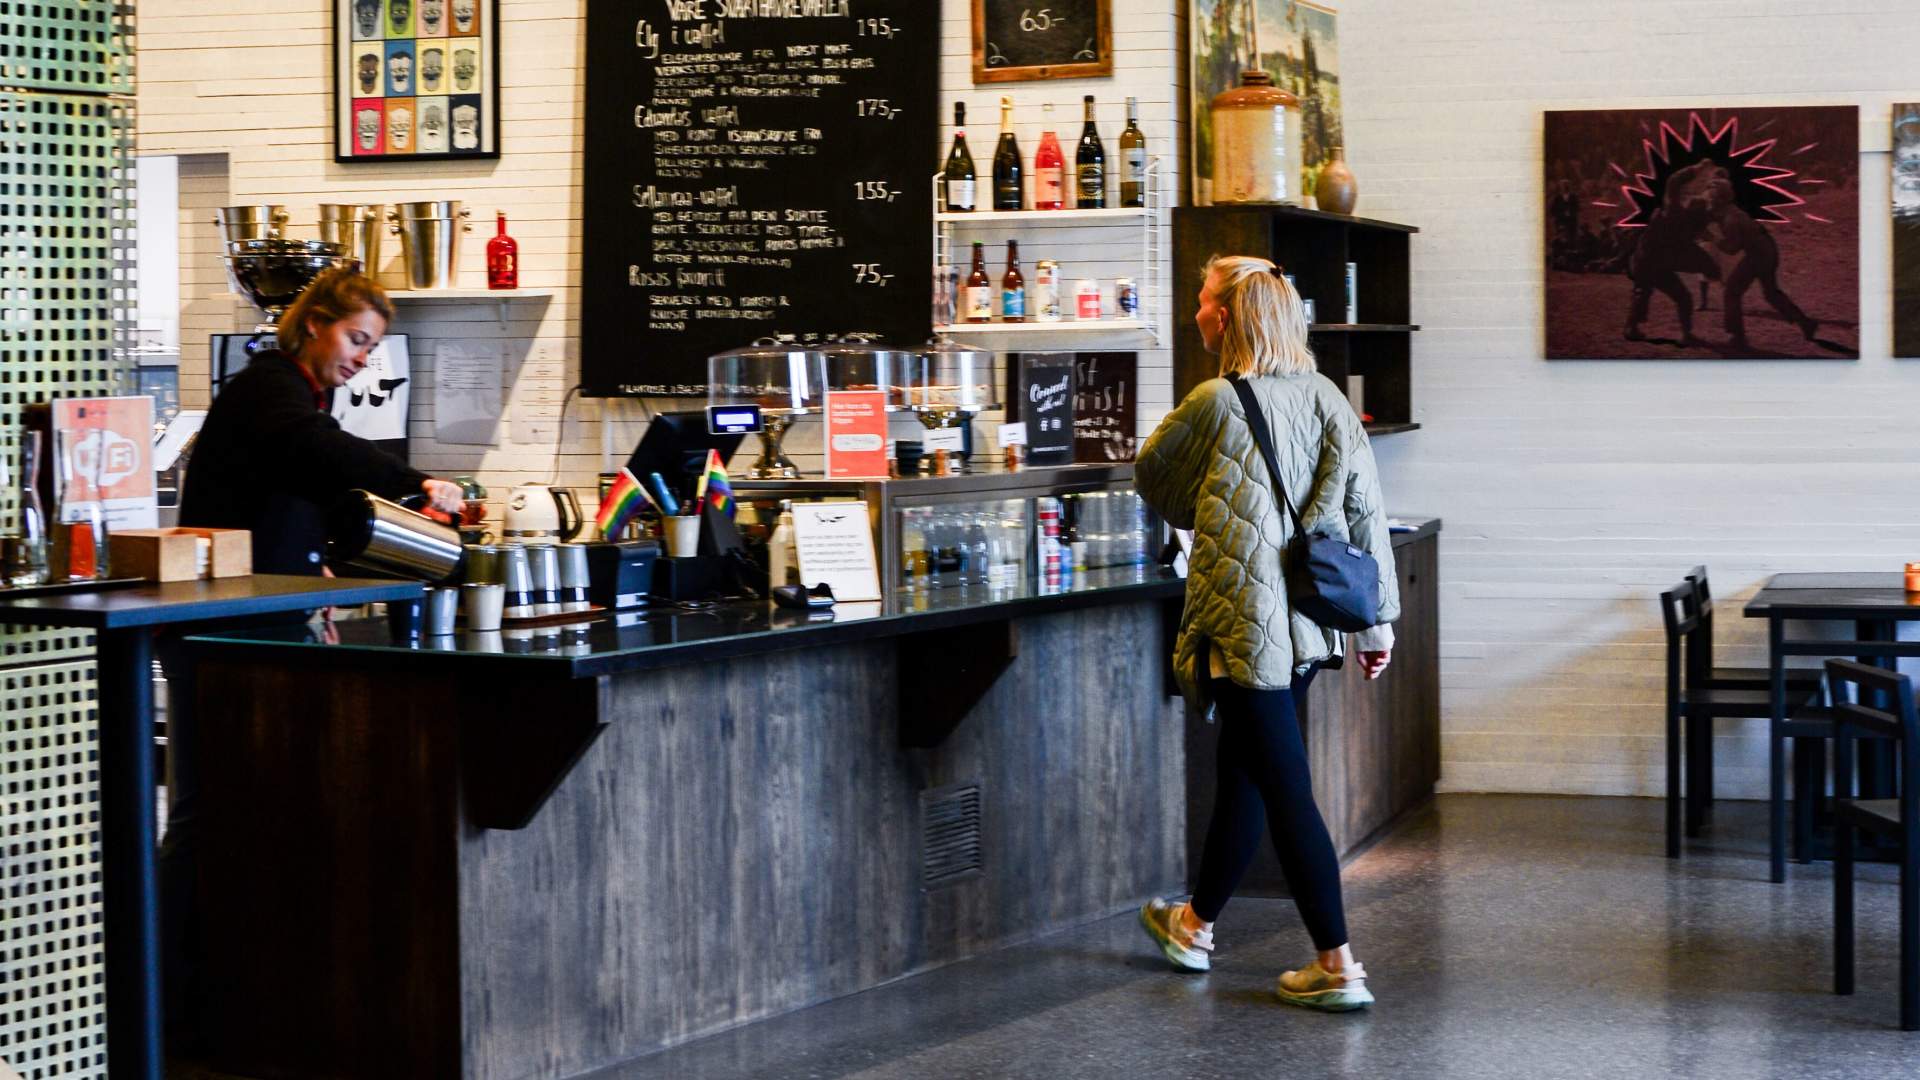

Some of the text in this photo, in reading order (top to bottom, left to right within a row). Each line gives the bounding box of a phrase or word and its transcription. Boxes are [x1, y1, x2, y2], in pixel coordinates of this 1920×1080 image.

[857, 17, 902, 39] 195,-
[856, 98, 903, 120] 175,-
[854, 181, 903, 203] 155,-
[852, 263, 896, 286] 75,-
